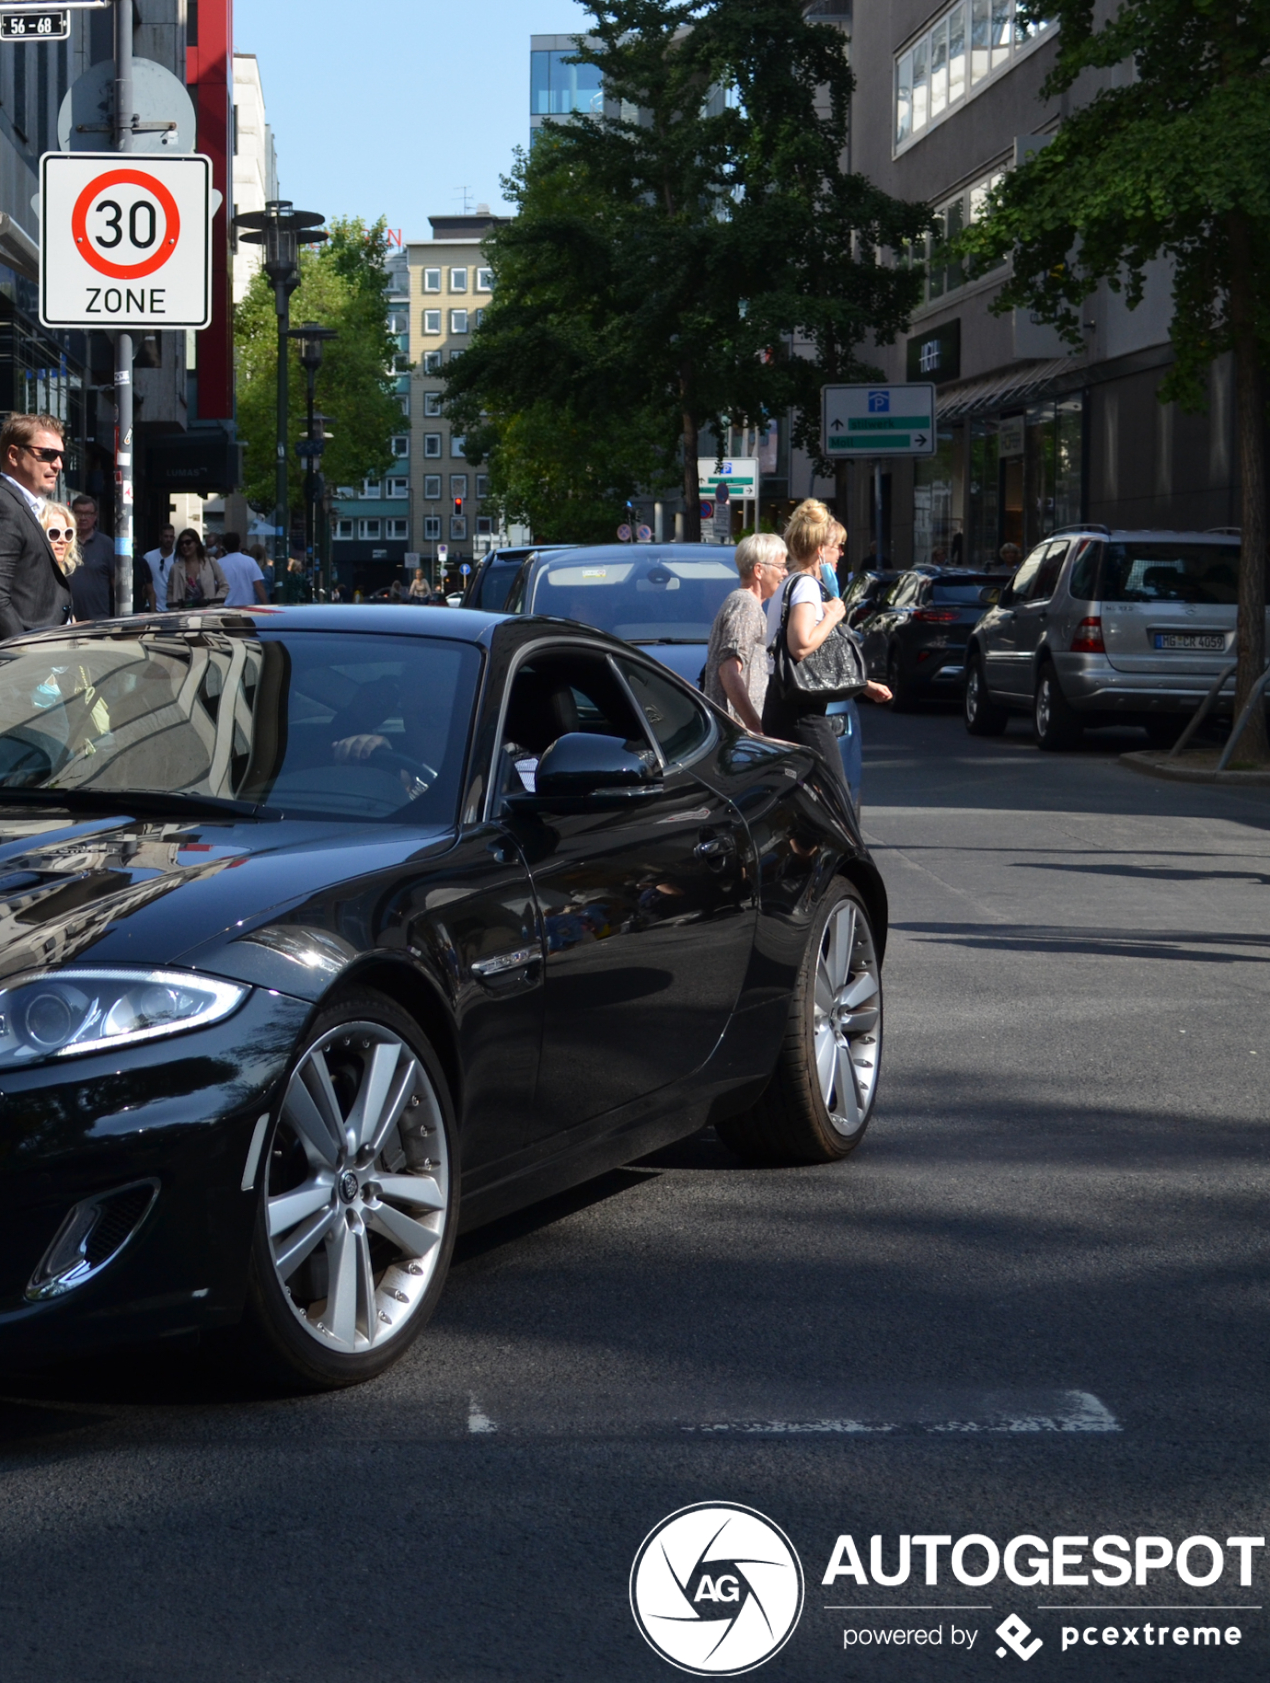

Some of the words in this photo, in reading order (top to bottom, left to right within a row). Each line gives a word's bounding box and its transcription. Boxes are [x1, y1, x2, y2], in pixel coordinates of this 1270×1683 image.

[95, 199, 157, 249] 30
[85, 287, 167, 314] ZONE
[851, 419, 896, 430] stilwerk
[166, 467, 200, 478] LUMAS
[1162, 635, 1176, 647] MG
[1182, 636, 1196, 648] CR
[1198, 636, 1224, 649] 4059
